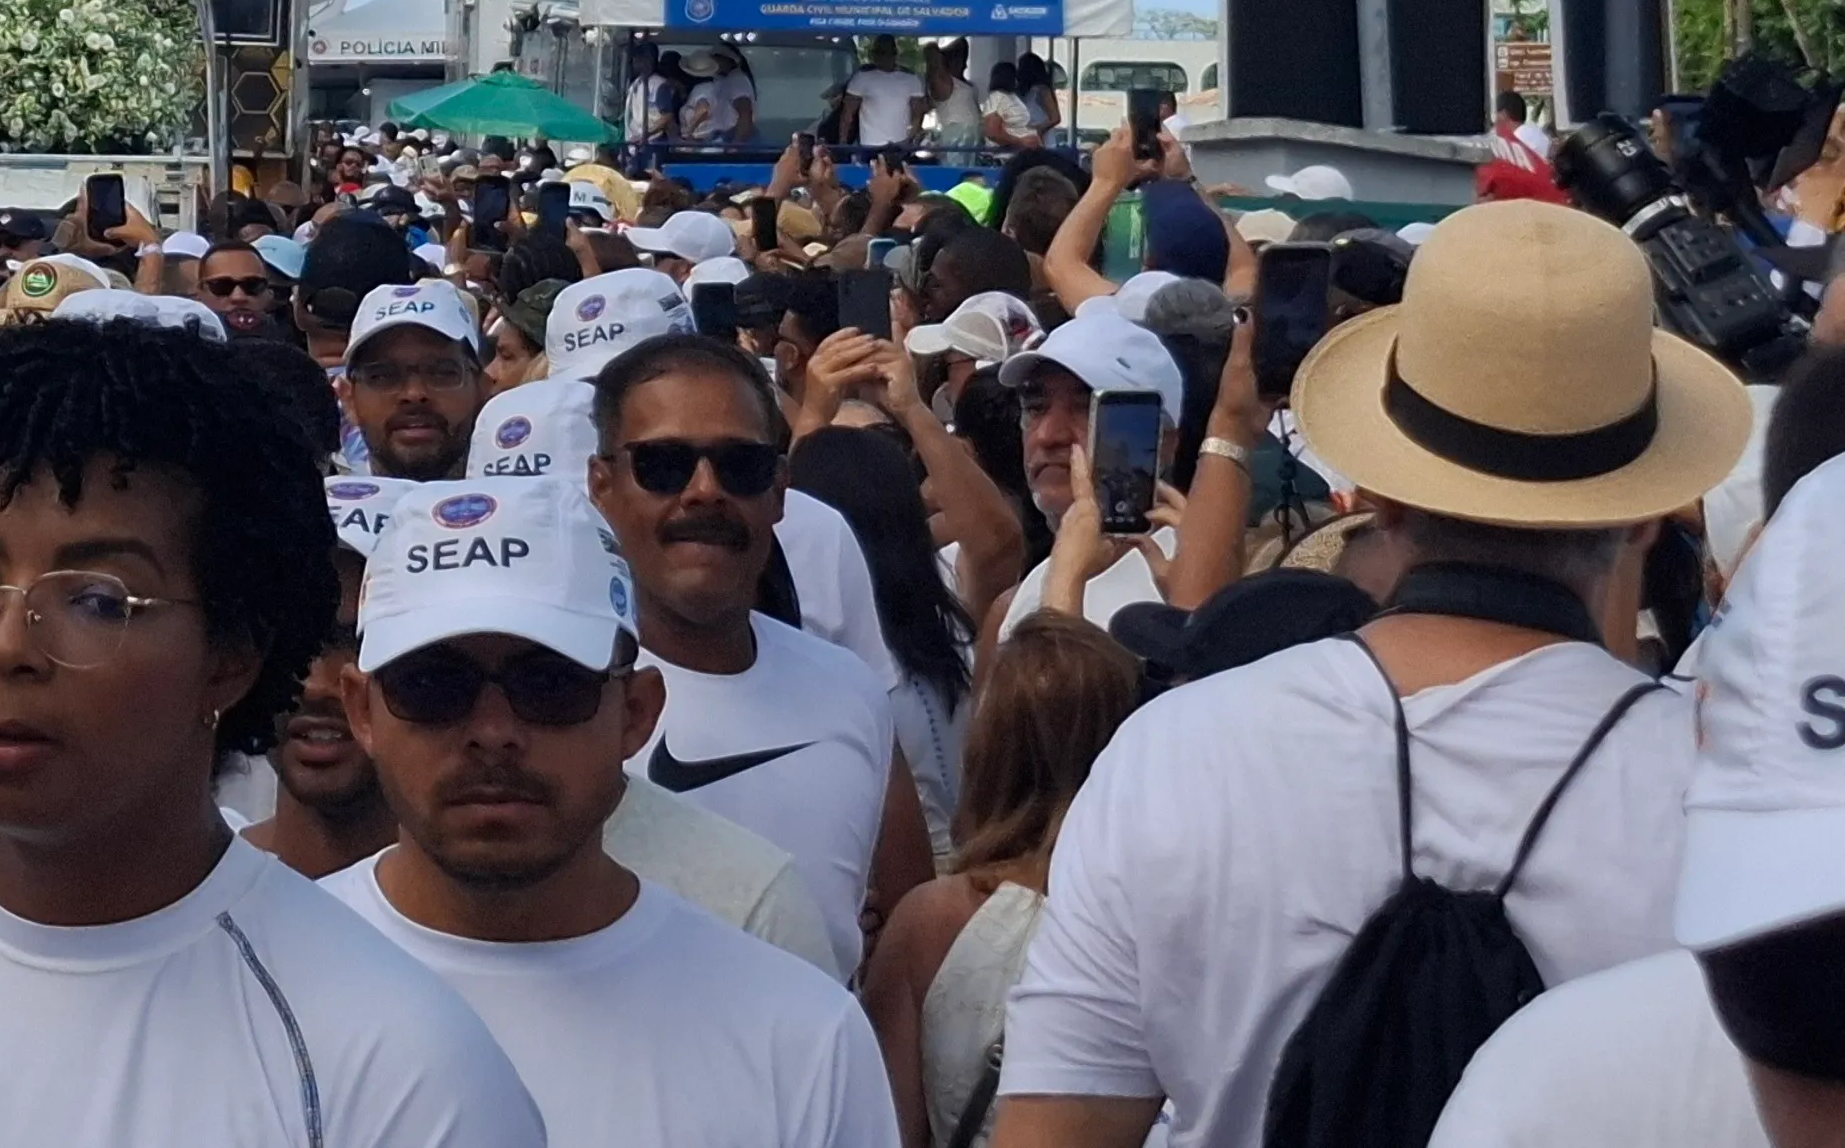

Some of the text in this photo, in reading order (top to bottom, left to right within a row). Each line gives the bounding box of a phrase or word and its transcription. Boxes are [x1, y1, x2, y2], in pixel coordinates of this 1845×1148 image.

[759, 3, 805, 16] GUARDA
[340, 36, 416, 55] POLÍCIA
[375, 300, 436, 321] SEAP
[564, 322, 625, 352] SEAP
[483, 453, 552, 477] SEAP
[406, 536, 530, 574] SEAP
